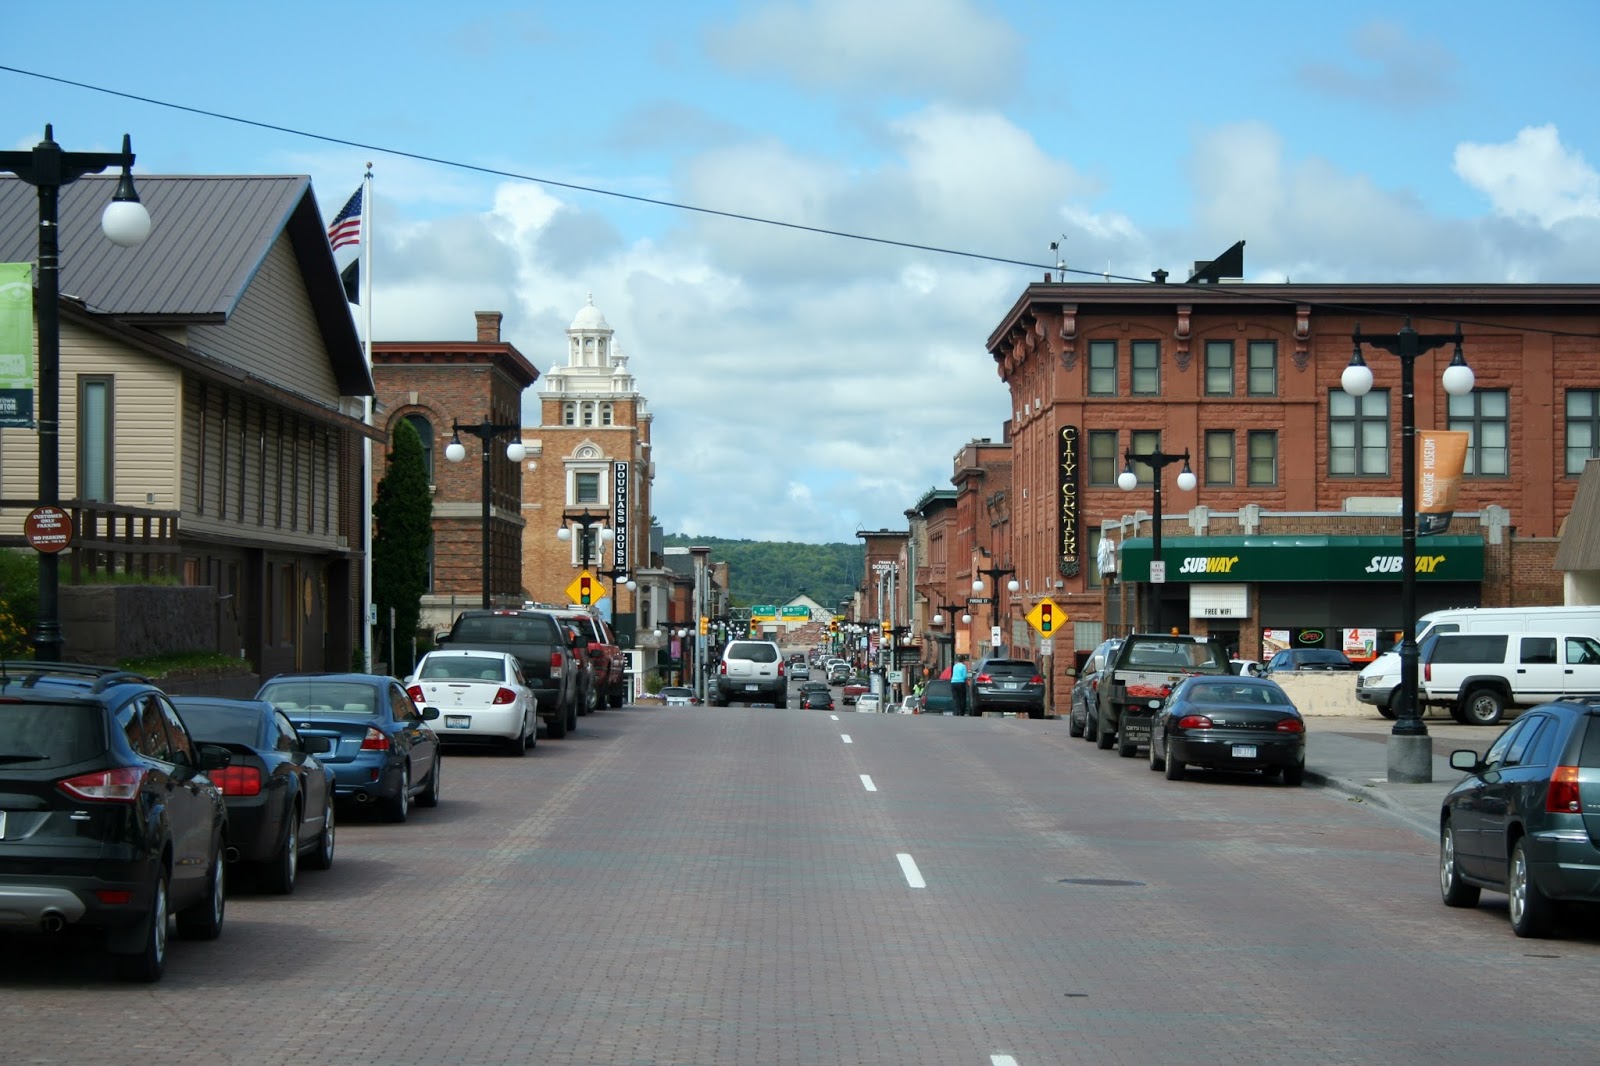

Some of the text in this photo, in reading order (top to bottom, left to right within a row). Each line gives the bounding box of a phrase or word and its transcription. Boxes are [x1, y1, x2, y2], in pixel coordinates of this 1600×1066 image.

[616, 463, 626, 524] DOUGLASS
[1061, 428, 1077, 554] CITY CENTER
[1422, 439, 1436, 508] CARNEGIE MUSEUM
[616, 527, 626, 565] HOUSE
[1179, 556, 1239, 574] SUBWAY
[1365, 555, 1446, 573] SUBAY
